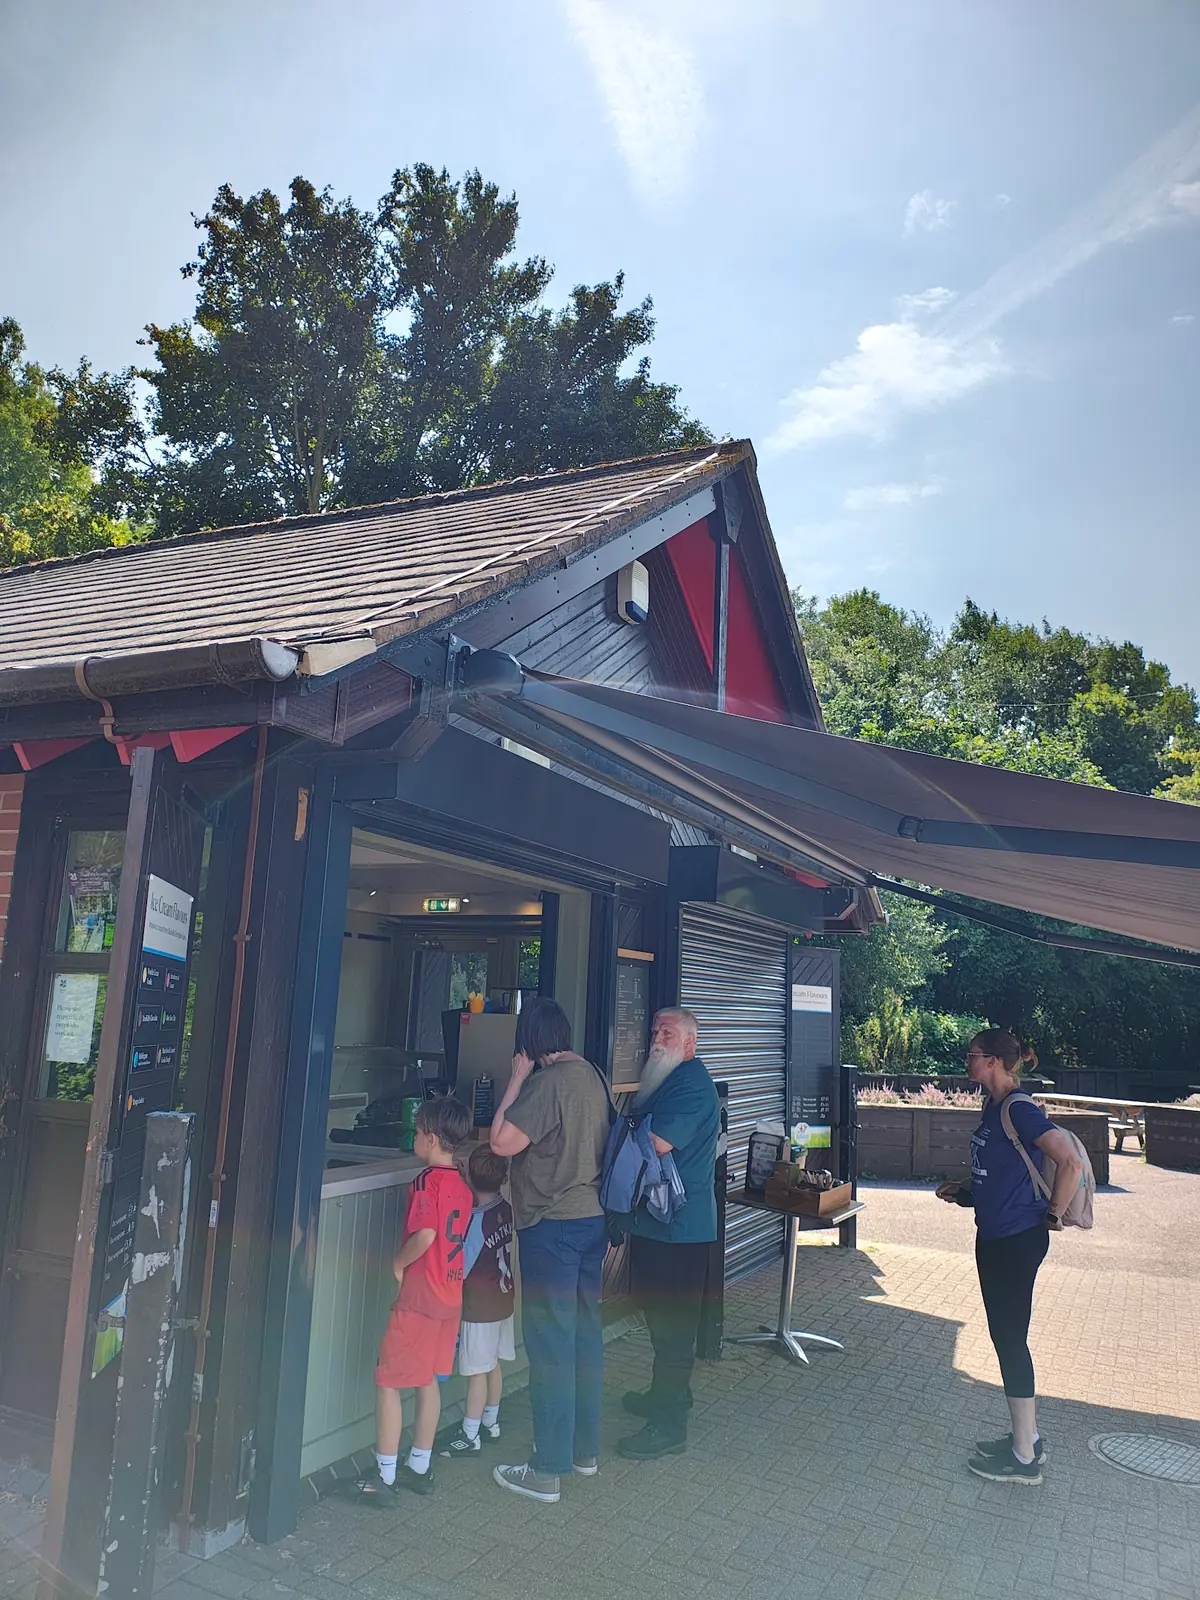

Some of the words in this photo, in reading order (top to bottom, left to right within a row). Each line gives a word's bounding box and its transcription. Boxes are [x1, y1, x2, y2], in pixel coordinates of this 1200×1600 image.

[150, 892, 158, 912] Ice
[159, 896, 173, 917] Cream
[172, 903, 188, 925] Flavours
[807, 991, 828, 999] Flavours
